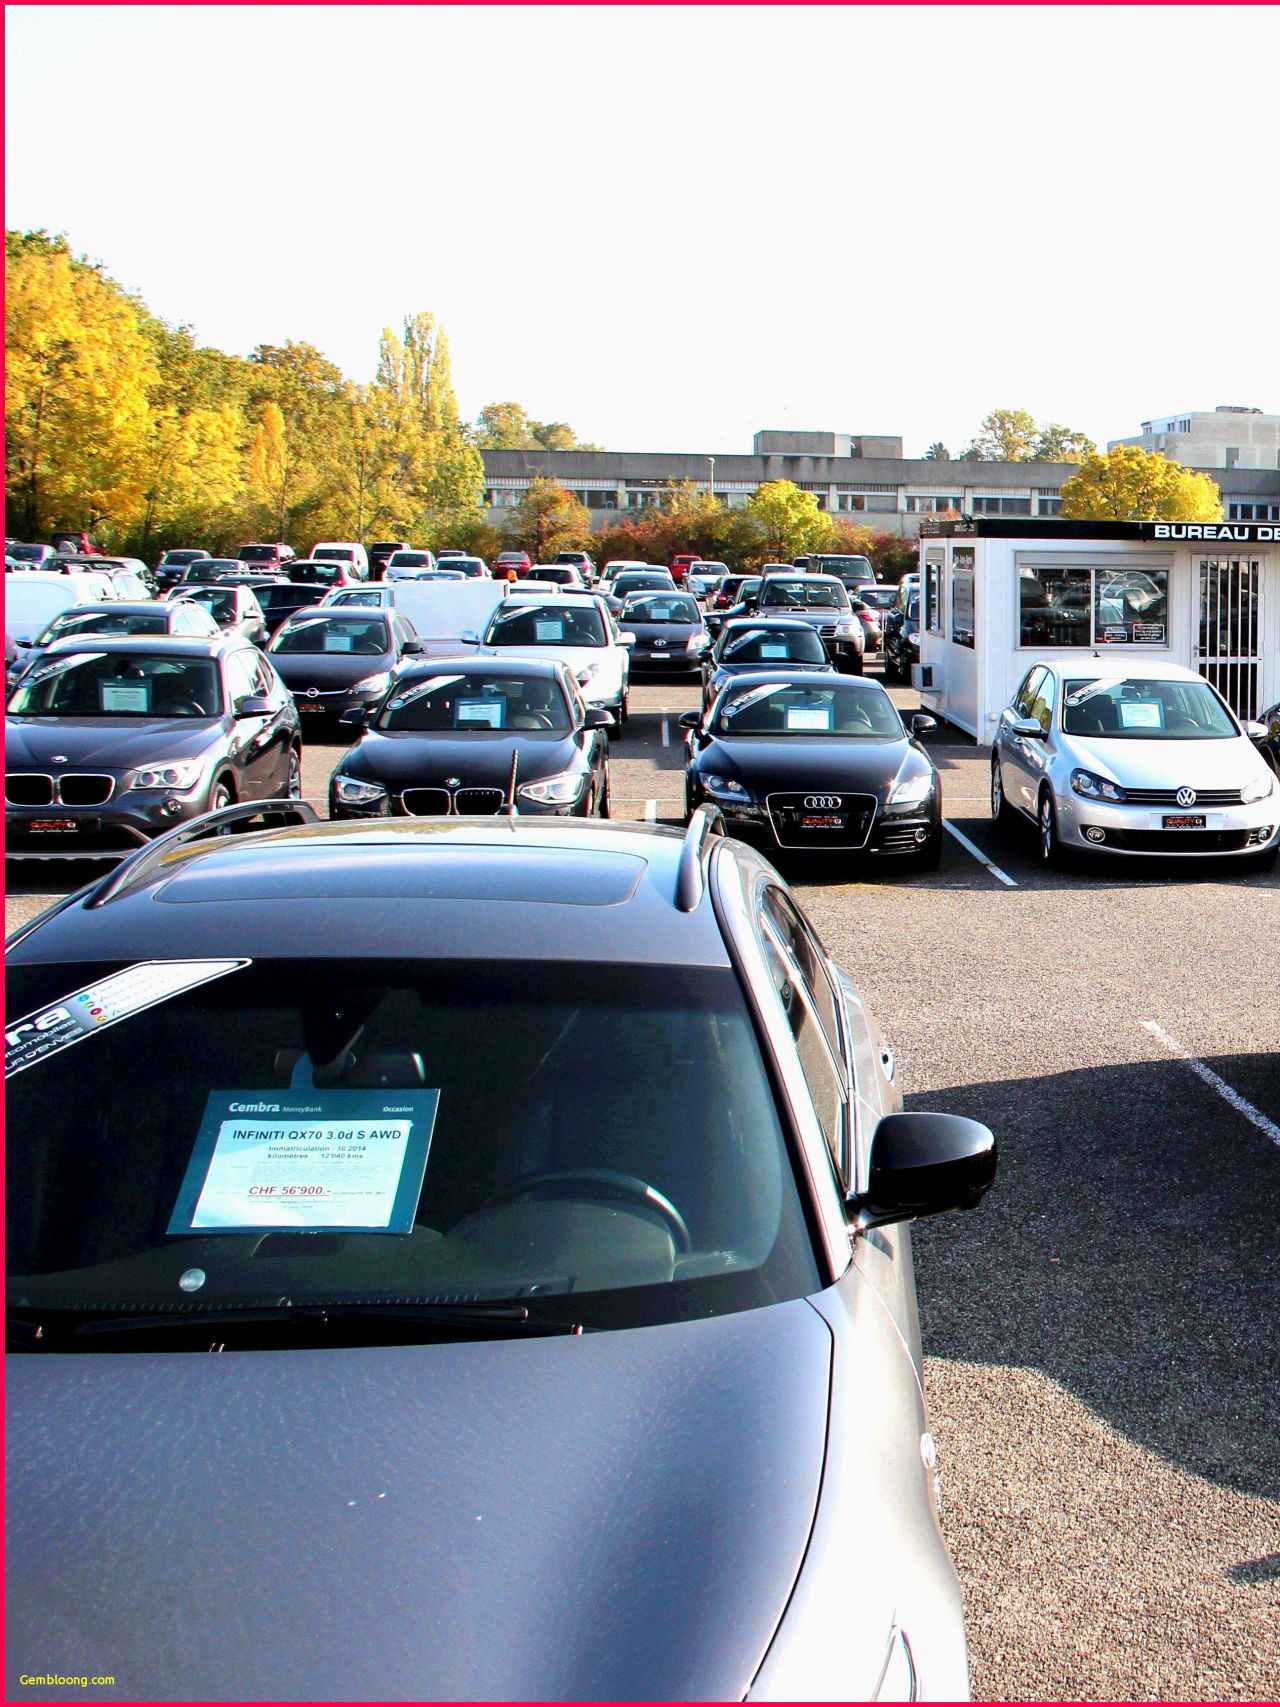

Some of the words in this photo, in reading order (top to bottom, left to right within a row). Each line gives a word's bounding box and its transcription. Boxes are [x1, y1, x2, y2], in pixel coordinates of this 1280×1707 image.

[1154, 525, 1249, 541] BUREAU
[229, 1102, 280, 1113] Cembra
[282, 1106, 322, 1114] MoneyBank
[233, 1130, 285, 1139] INFINITI
[288, 1130, 323, 1140] QX70
[326, 1130, 353, 1139] 3.0d
[357, 1130, 366, 1139] S
[370, 1130, 401, 1139] AWD
[249, 1186, 278, 1195] CHF
